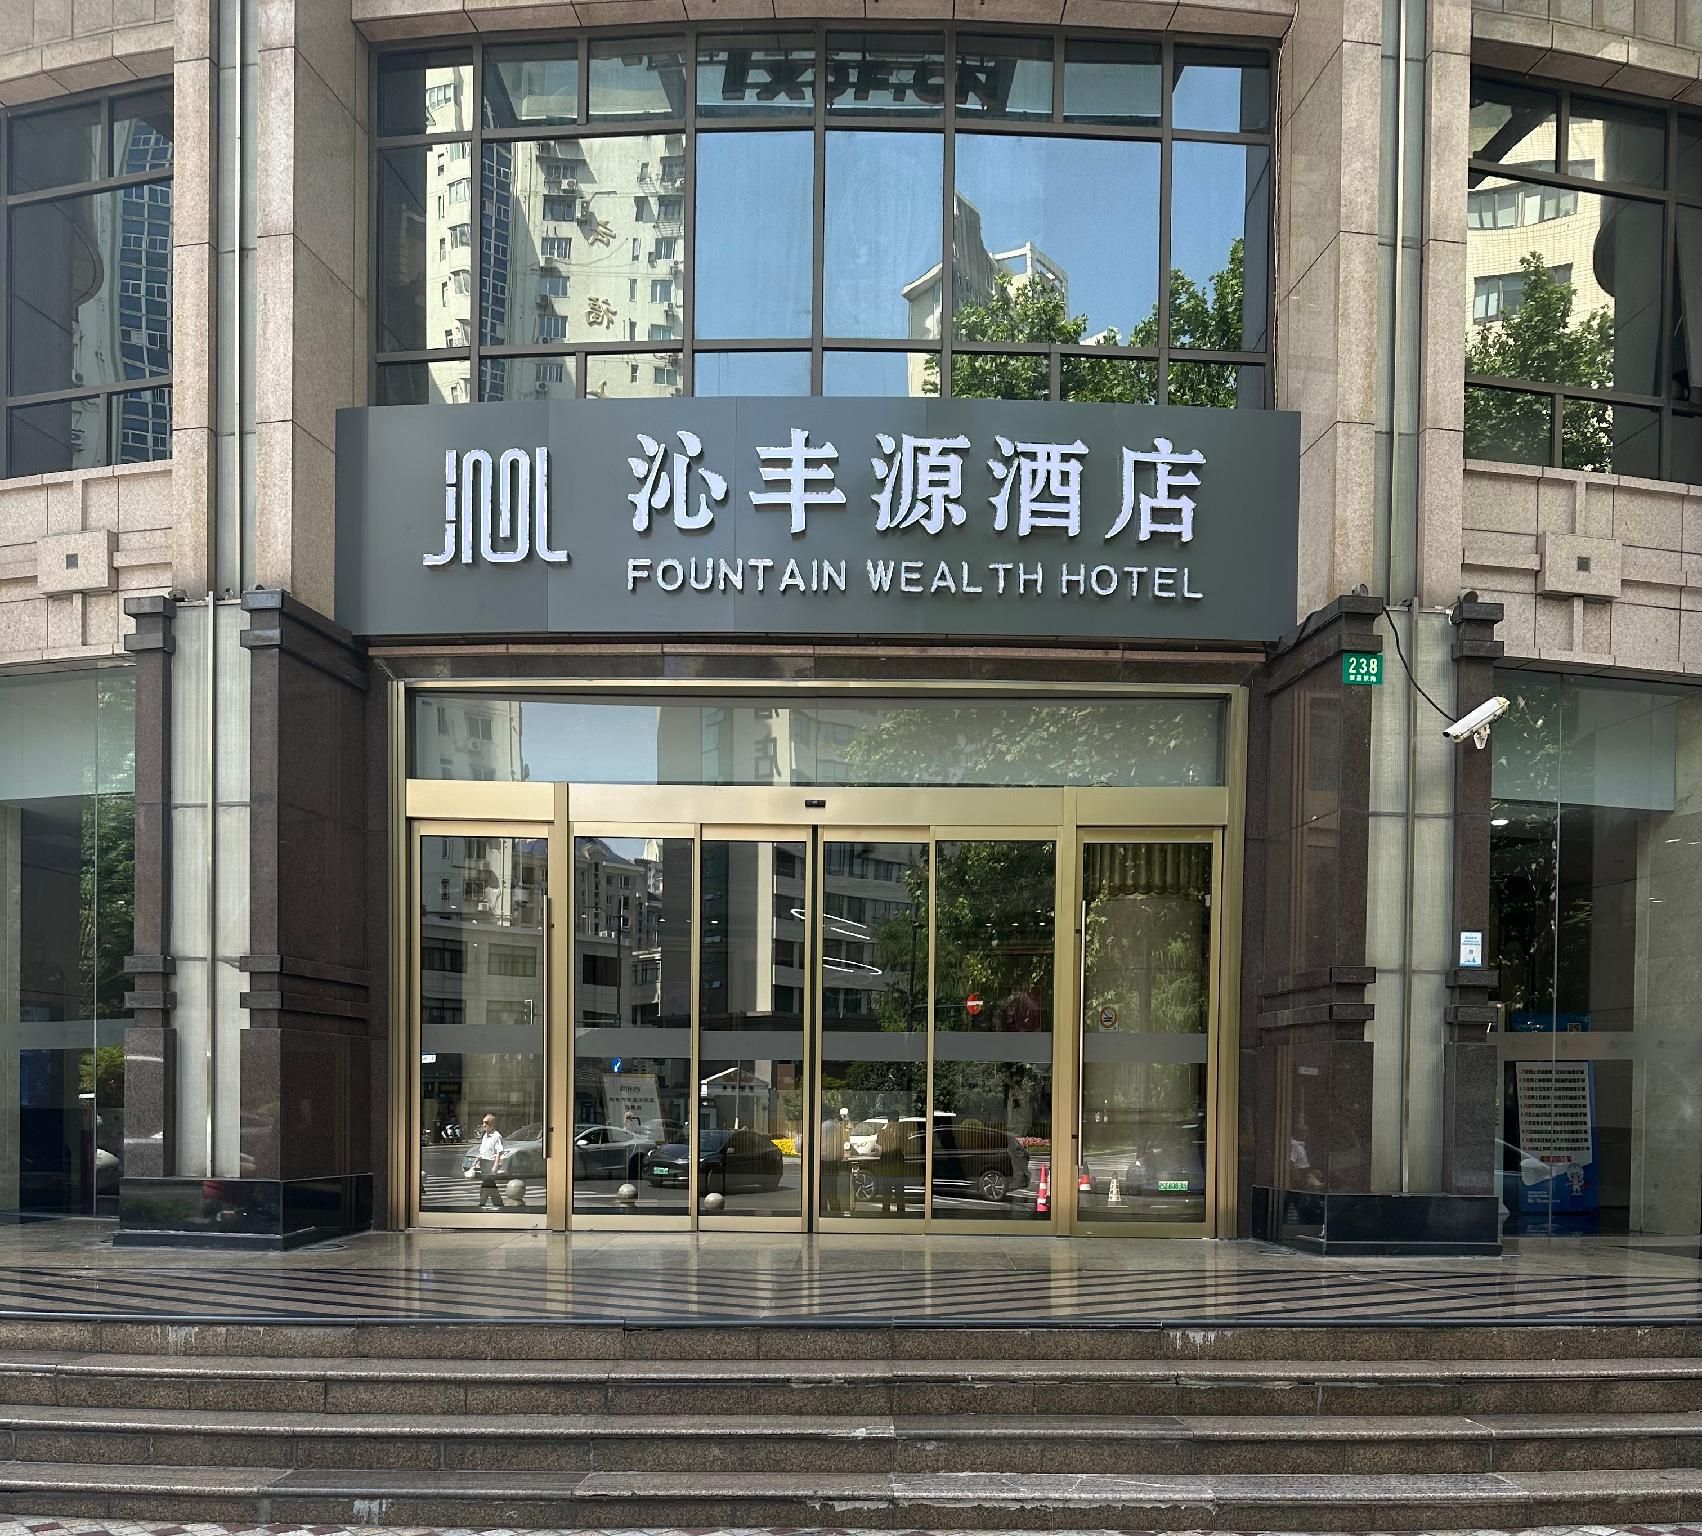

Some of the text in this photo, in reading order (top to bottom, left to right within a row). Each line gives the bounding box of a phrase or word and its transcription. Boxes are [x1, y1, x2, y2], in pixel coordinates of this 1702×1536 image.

[628, 428, 1206, 542] 沁丰源酒店
[628, 557, 1203, 597] FOUNTAIN WEALTH HOTEL
[1348, 656, 1378, 674] 238
